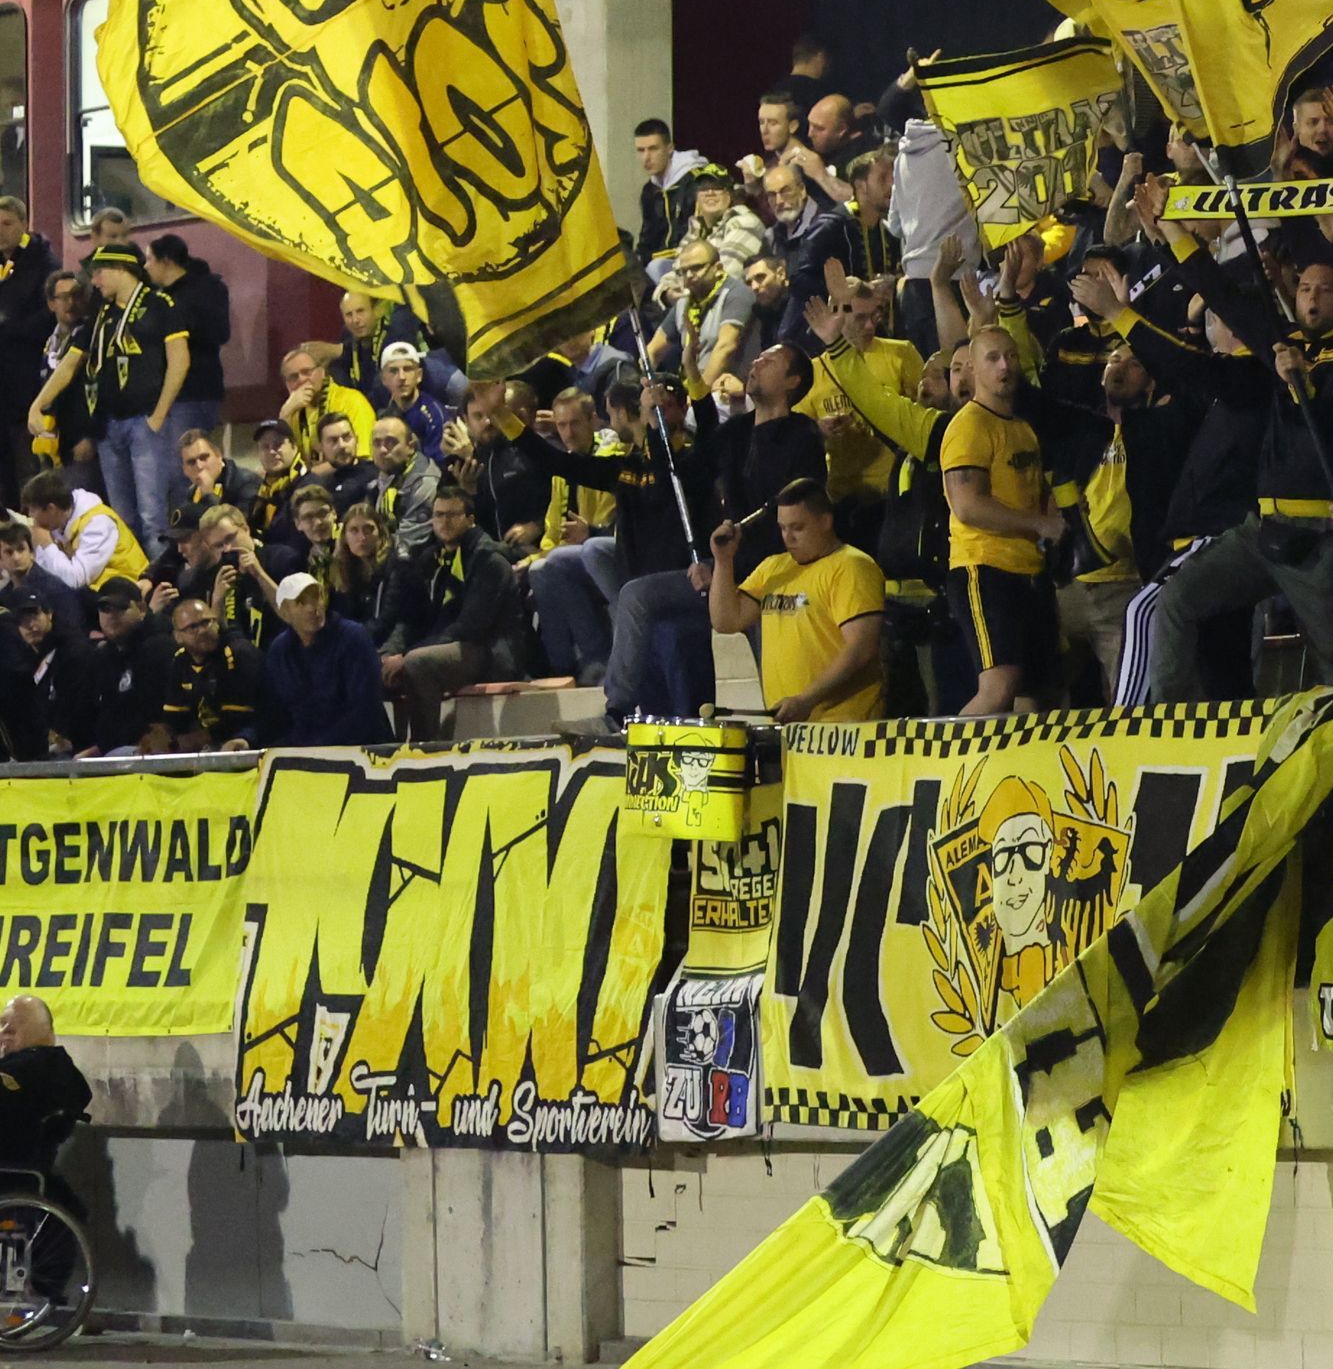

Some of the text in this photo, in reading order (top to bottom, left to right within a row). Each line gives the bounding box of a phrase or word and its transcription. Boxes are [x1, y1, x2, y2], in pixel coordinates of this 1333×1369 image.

[786, 722, 861, 757] YELLOW
[0, 815, 251, 886] TGENWALD
[731, 874, 775, 902] REGE
[0, 912, 194, 988] REIFEL
[236, 1070, 343, 1139] Aachener
[453, 1082, 501, 1138] und
[662, 1066, 703, 1123] ZU
